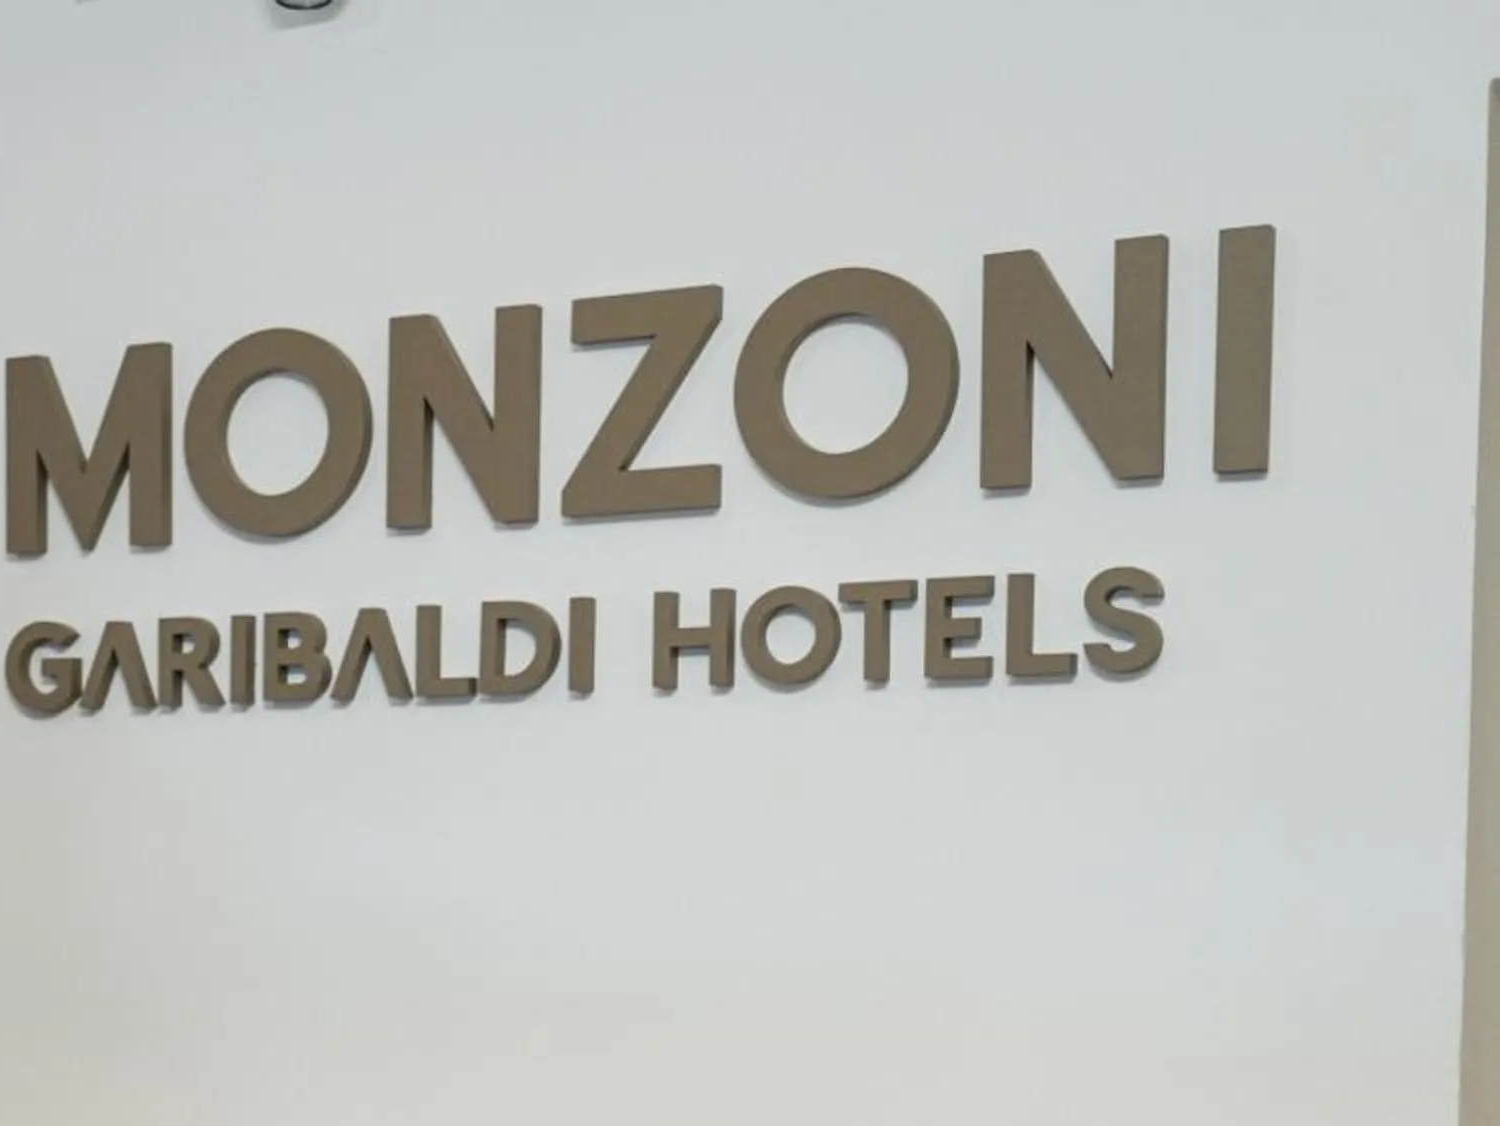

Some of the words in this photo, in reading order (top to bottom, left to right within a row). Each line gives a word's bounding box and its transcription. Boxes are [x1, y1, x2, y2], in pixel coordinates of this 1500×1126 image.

[4, 224, 1276, 558] MONZONI
[4, 595, 598, 716] GARIBALDI
[652, 566, 1166, 692] HOTELS
